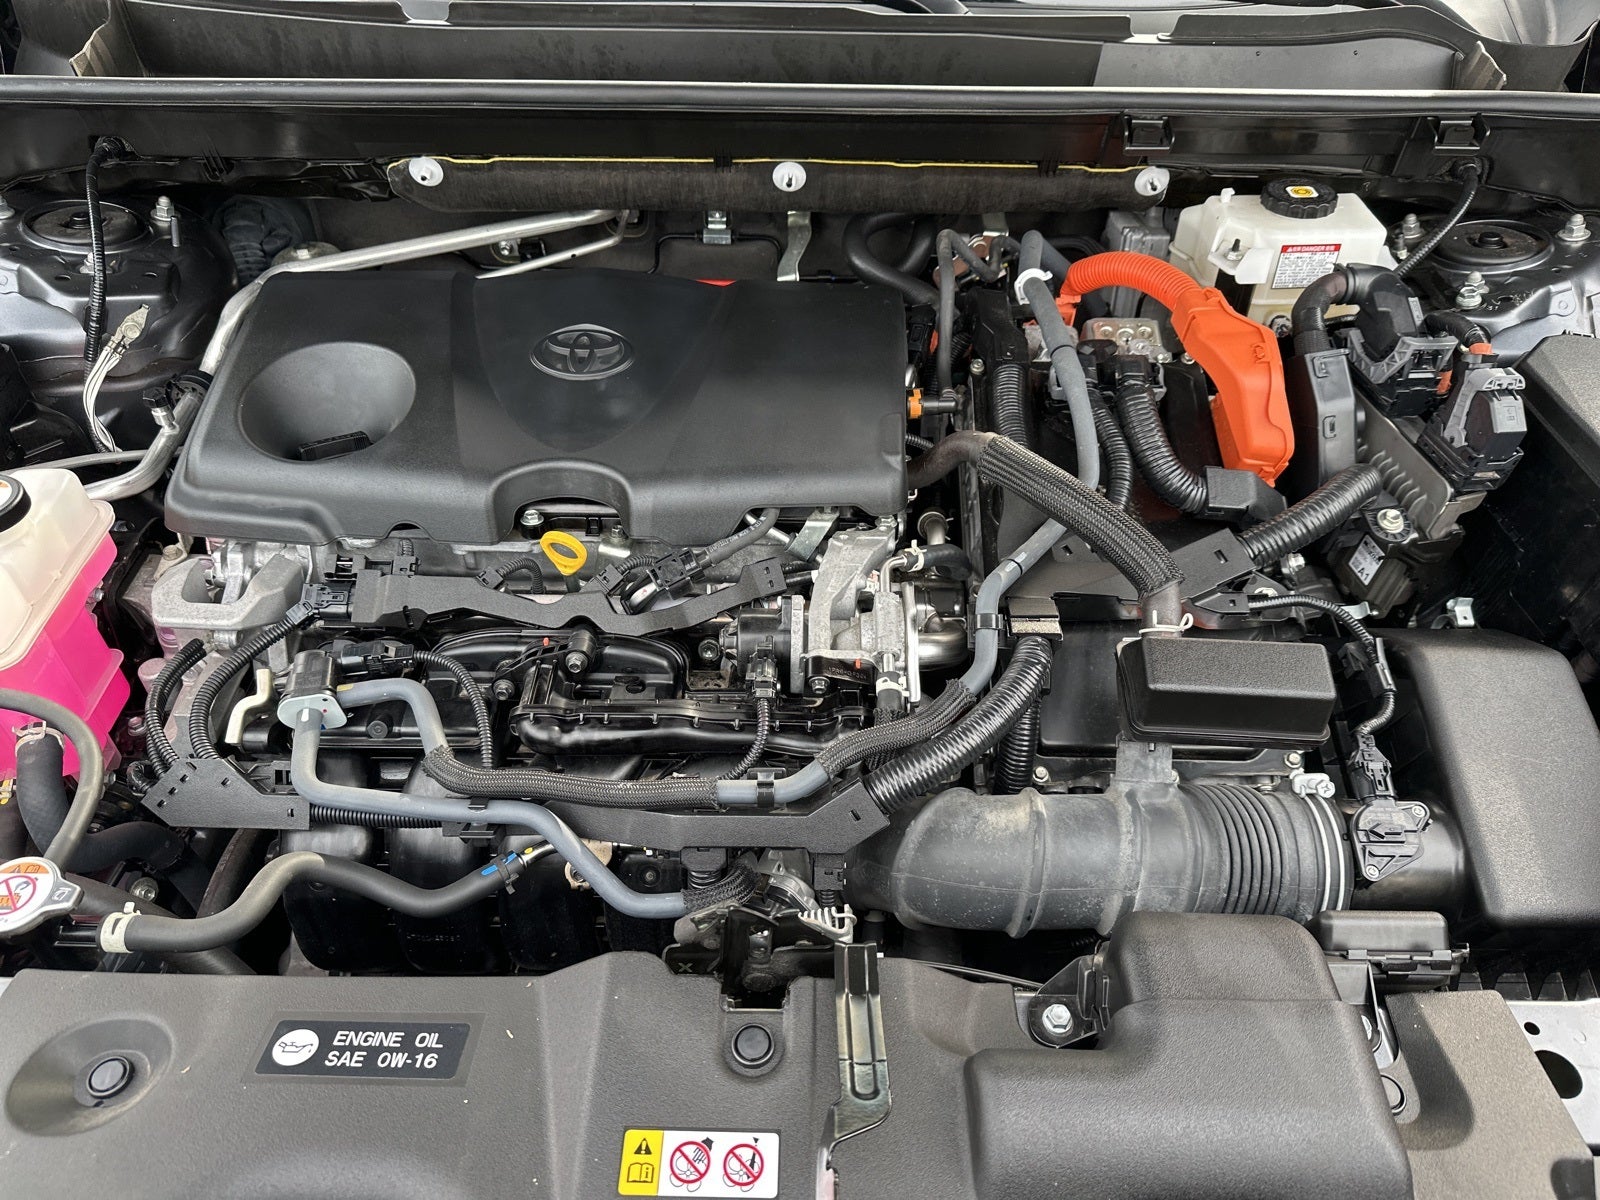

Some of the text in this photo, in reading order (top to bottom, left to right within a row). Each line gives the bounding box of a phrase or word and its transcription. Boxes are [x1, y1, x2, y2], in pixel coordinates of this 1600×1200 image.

[332, 1030, 444, 1049] ENGINE OIL
[324, 1051, 439, 1069] SAE 0W-16
